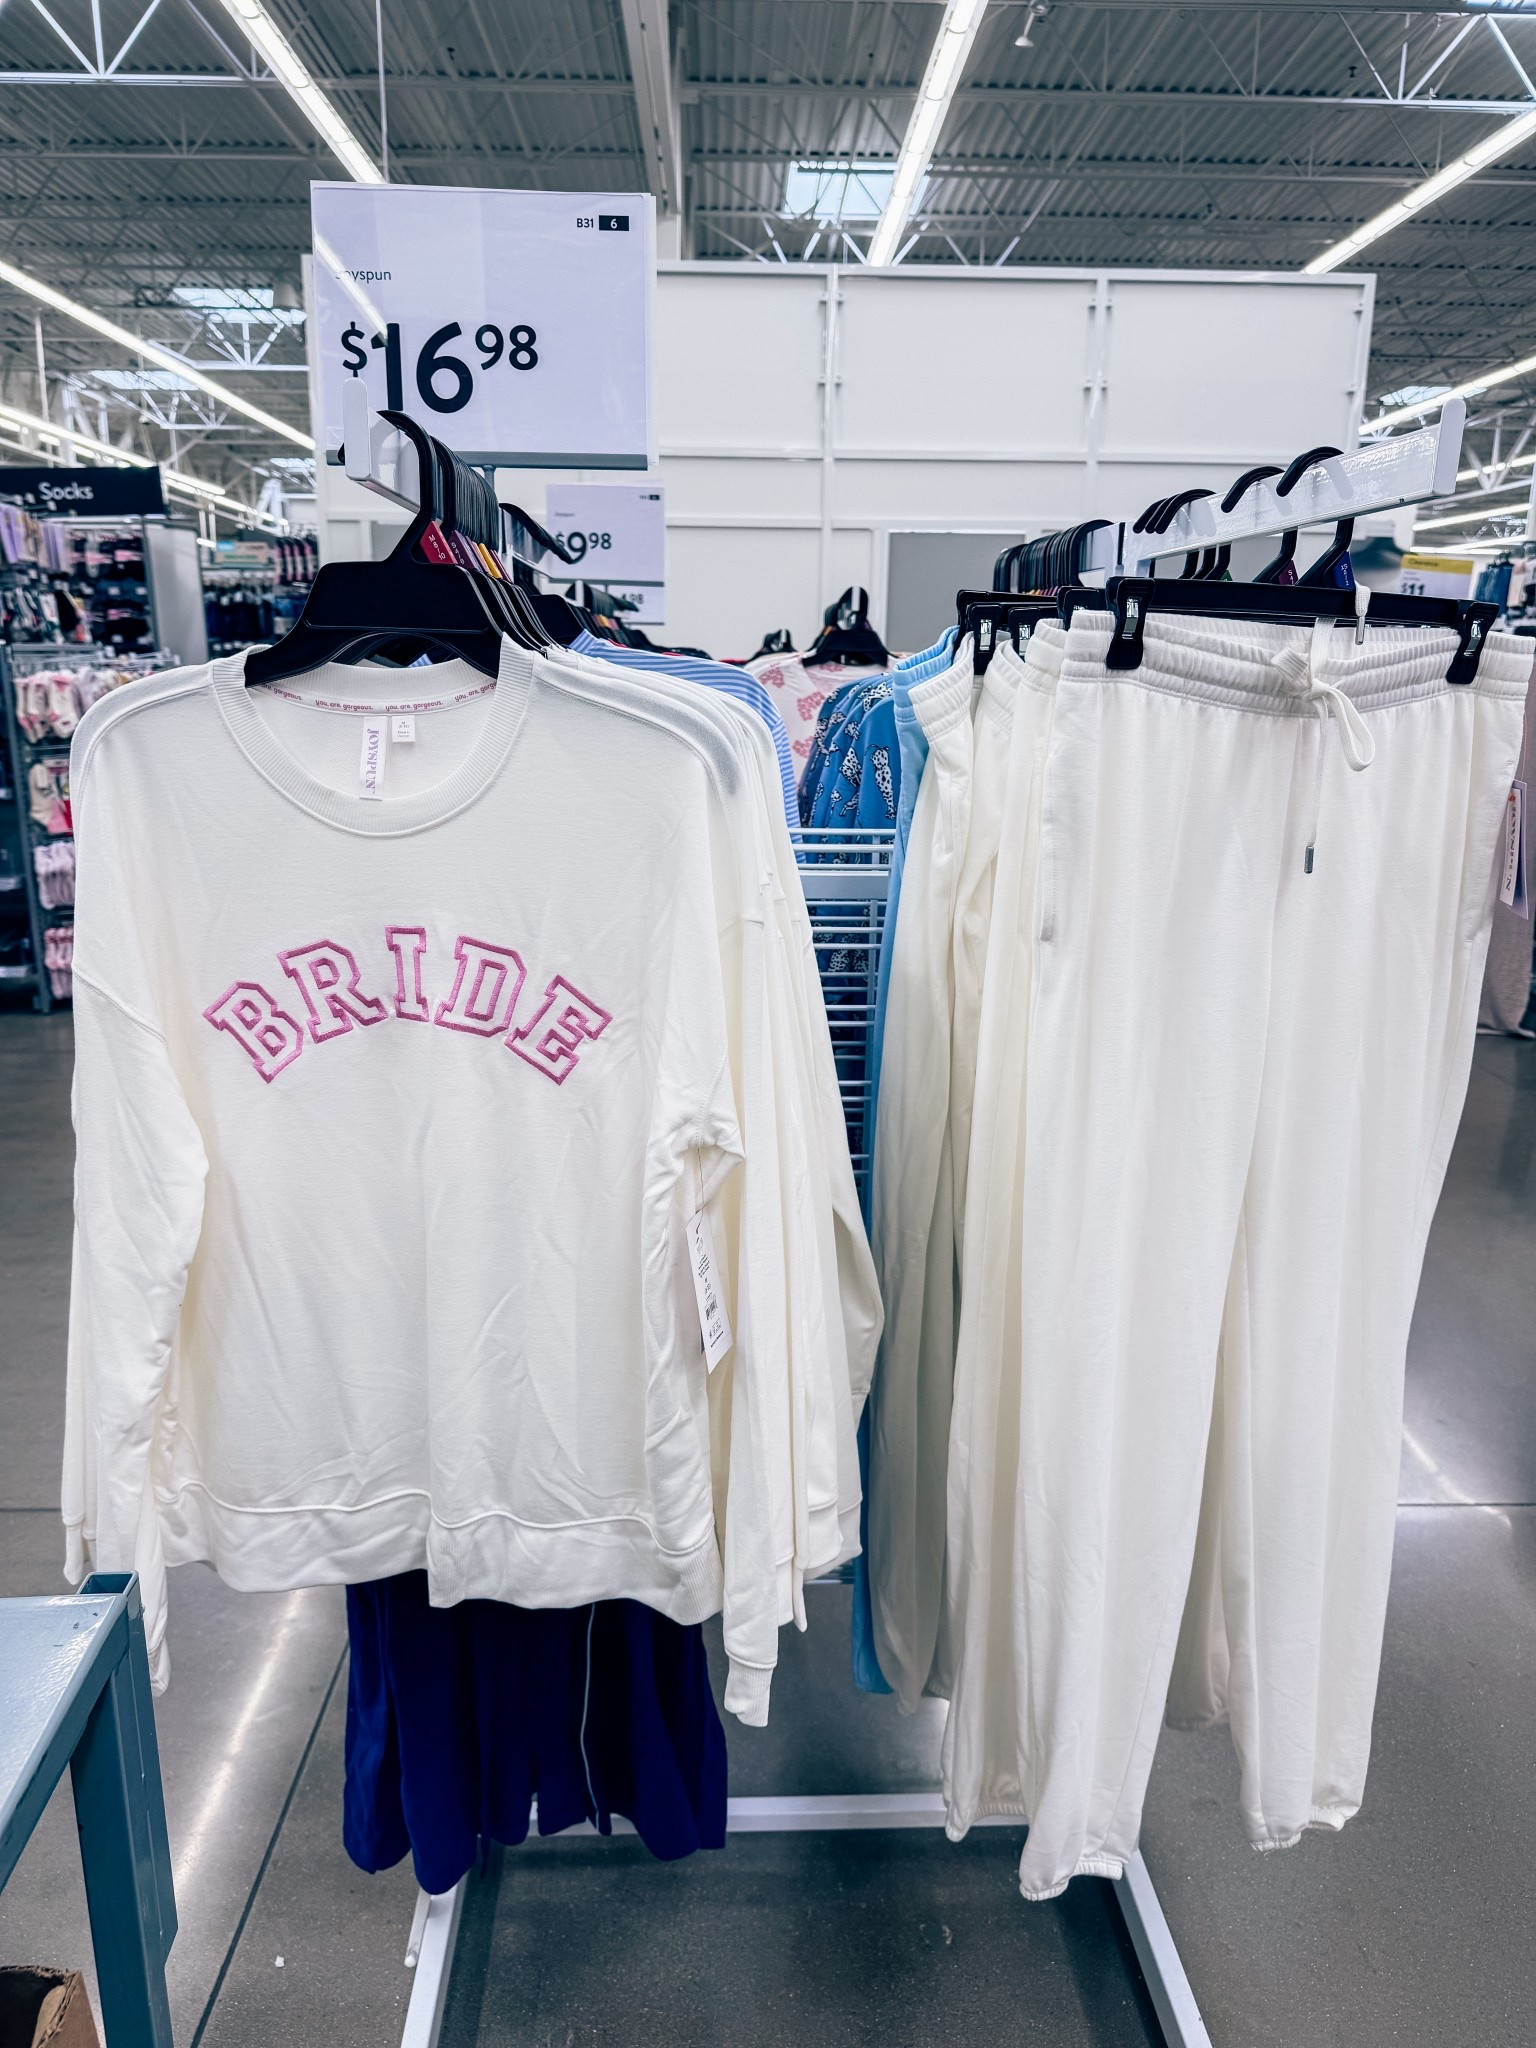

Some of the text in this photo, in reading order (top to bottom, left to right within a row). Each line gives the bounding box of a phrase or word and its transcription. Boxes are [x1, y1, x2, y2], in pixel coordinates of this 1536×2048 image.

[576, 217, 618, 229] B31 6
[335, 270, 392, 285] yspun
[38, 481, 94, 501] Socks
[273, 687, 304, 701] gorgeous.
[454, 694, 469, 702] you.
[468, 688, 480, 696] are.
[315, 699, 329, 707] you.
[342, 703, 374, 711] gorgeous.
[385, 704, 399, 712] you.
[413, 700, 444, 710] gorgeous.
[365, 728, 380, 792] JOYSPUN
[202, 924, 613, 1086] BRIDE
